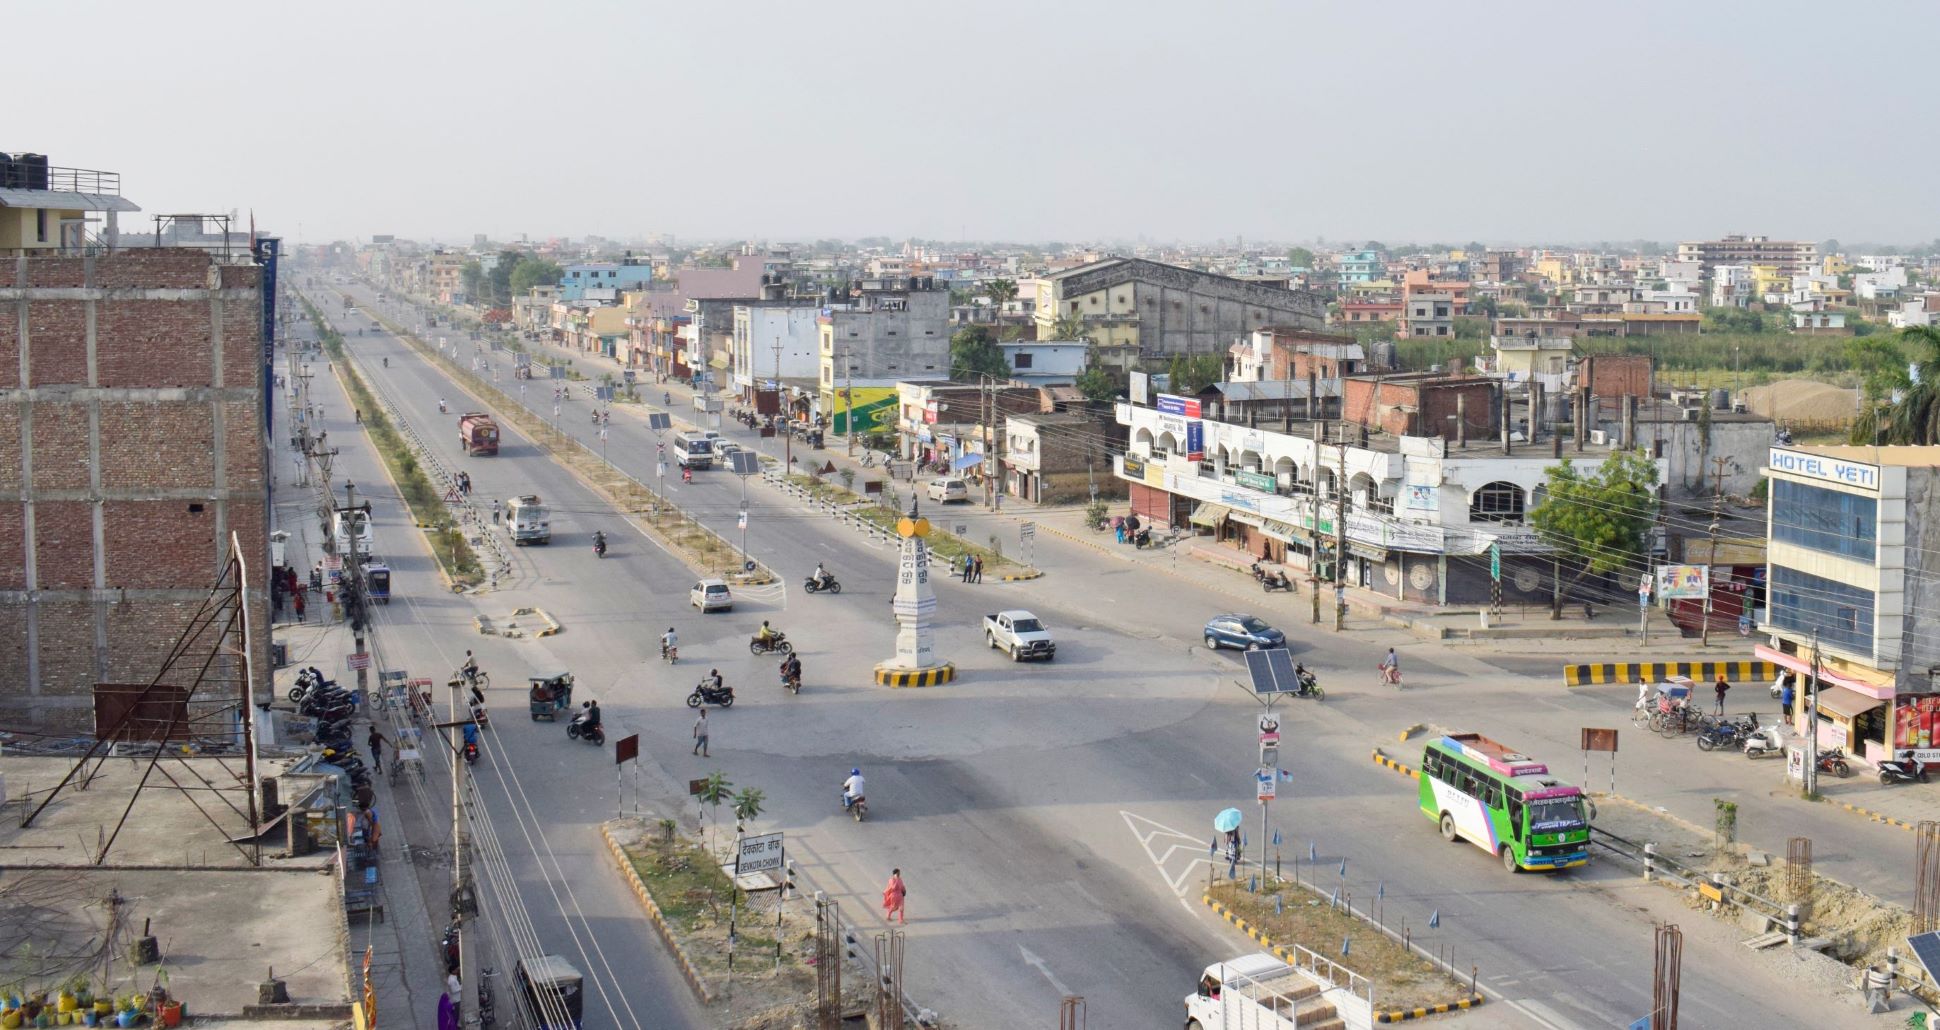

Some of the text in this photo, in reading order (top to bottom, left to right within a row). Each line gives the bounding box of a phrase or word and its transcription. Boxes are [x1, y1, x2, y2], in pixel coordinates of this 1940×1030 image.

[1773, 452, 1873, 485] HOTEL YETI
[742, 839, 765, 856] देवकोटा
[740, 857, 780, 871] DEVKOTA CHOWK
